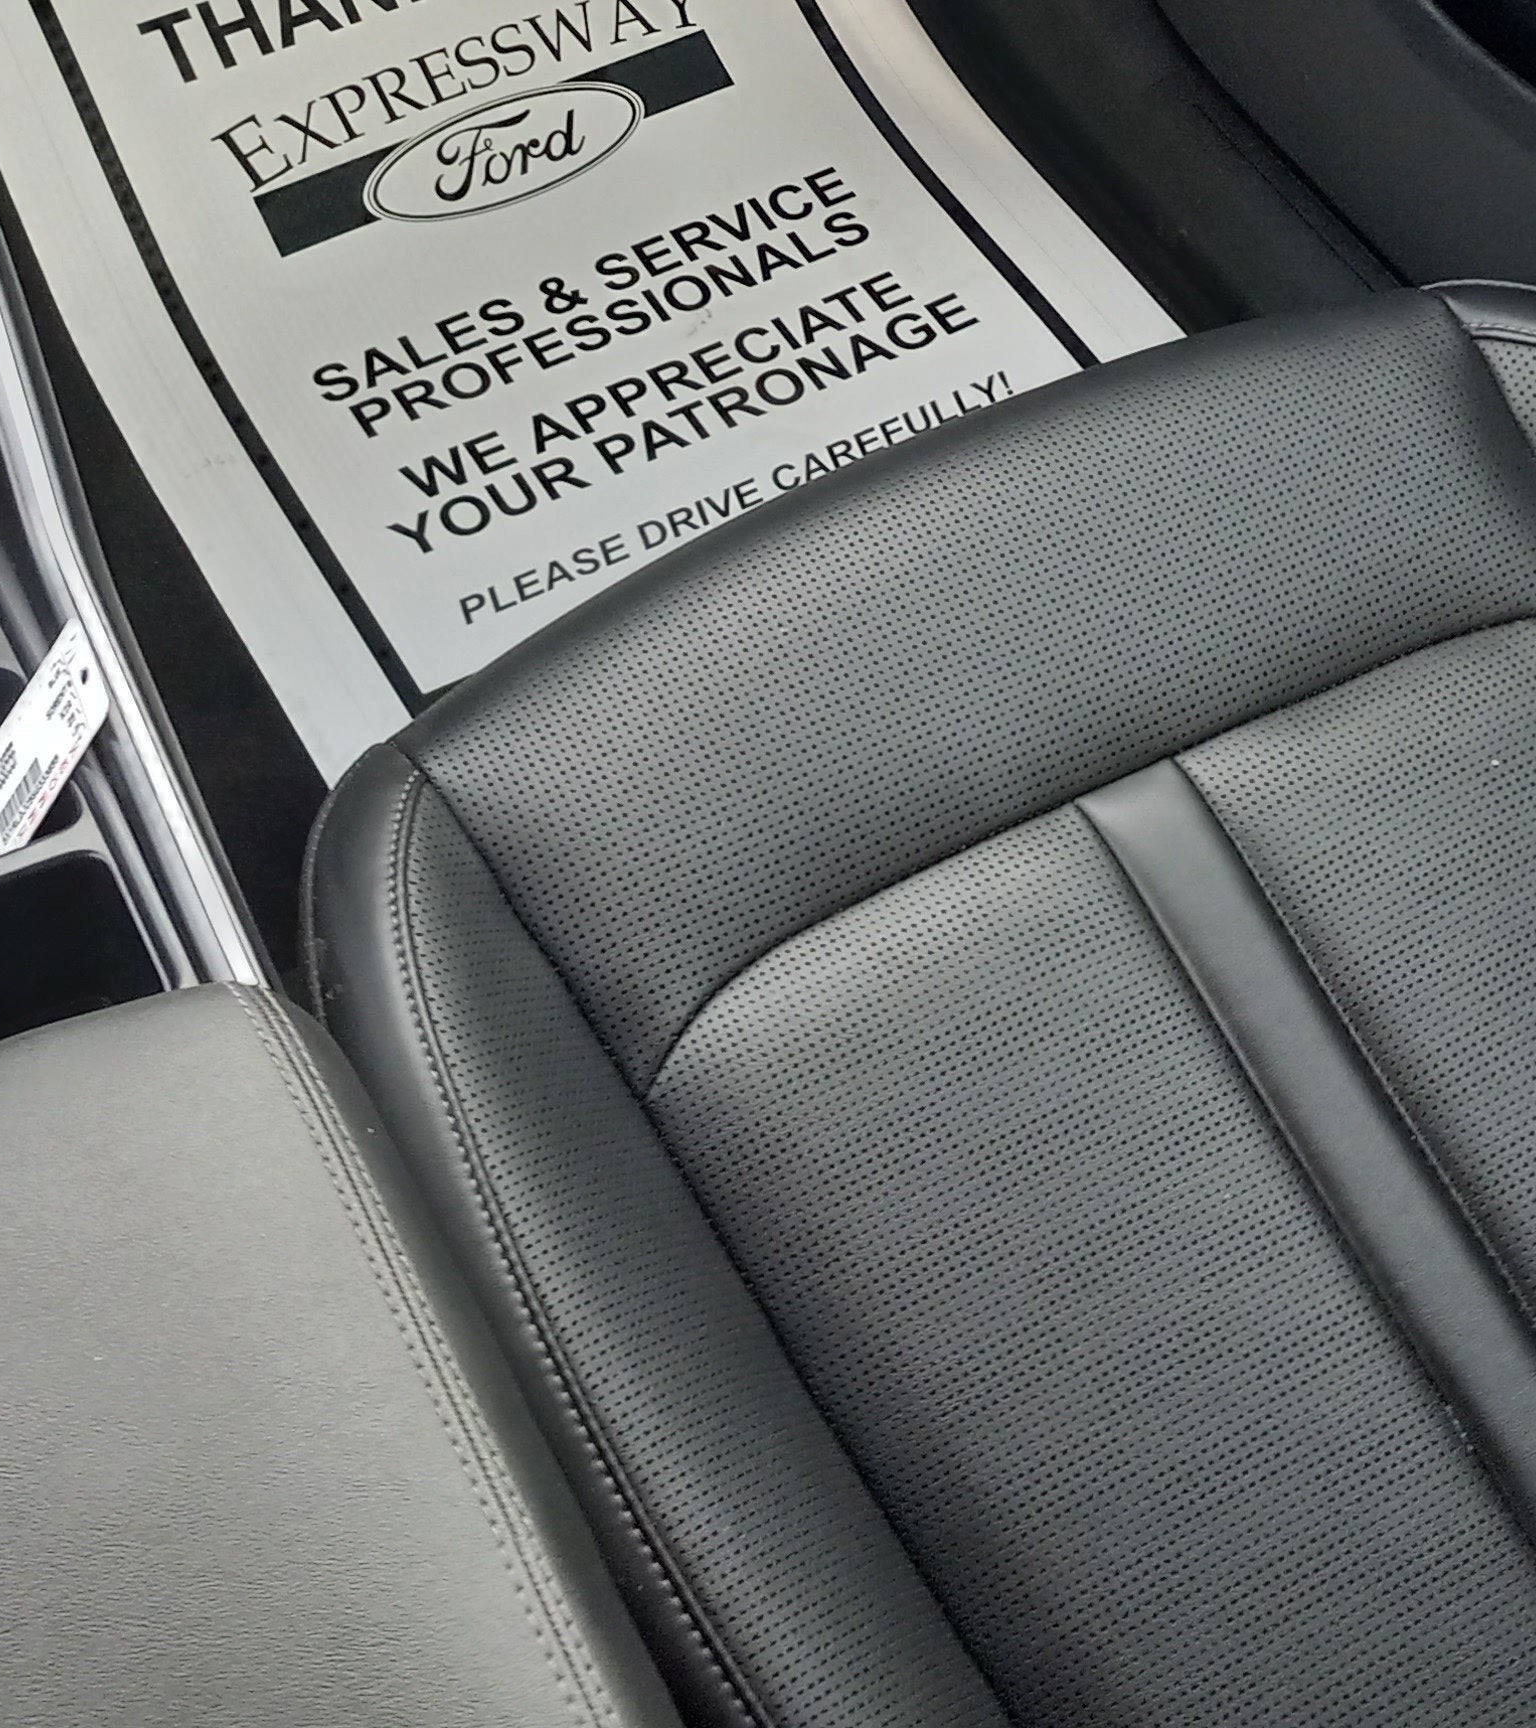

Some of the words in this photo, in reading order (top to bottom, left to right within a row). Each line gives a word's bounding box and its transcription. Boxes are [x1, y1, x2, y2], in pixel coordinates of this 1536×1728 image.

[434, 108, 586, 203] Ford
[312, 298, 525, 403] SALES
[538, 276, 589, 315] &
[594, 166, 857, 291] SERVICE
[348, 210, 870, 439] PROFESSIONALS
[399, 430, 517, 499] WE
[530, 271, 916, 455] APPRECIATE
[386, 455, 592, 556] YOUR
[593, 292, 980, 475] PATRONAGE
[458, 533, 631, 625] PLEASE
[637, 477, 764, 551] DRIVE
[771, 370, 1015, 492] CAREFULLY!
